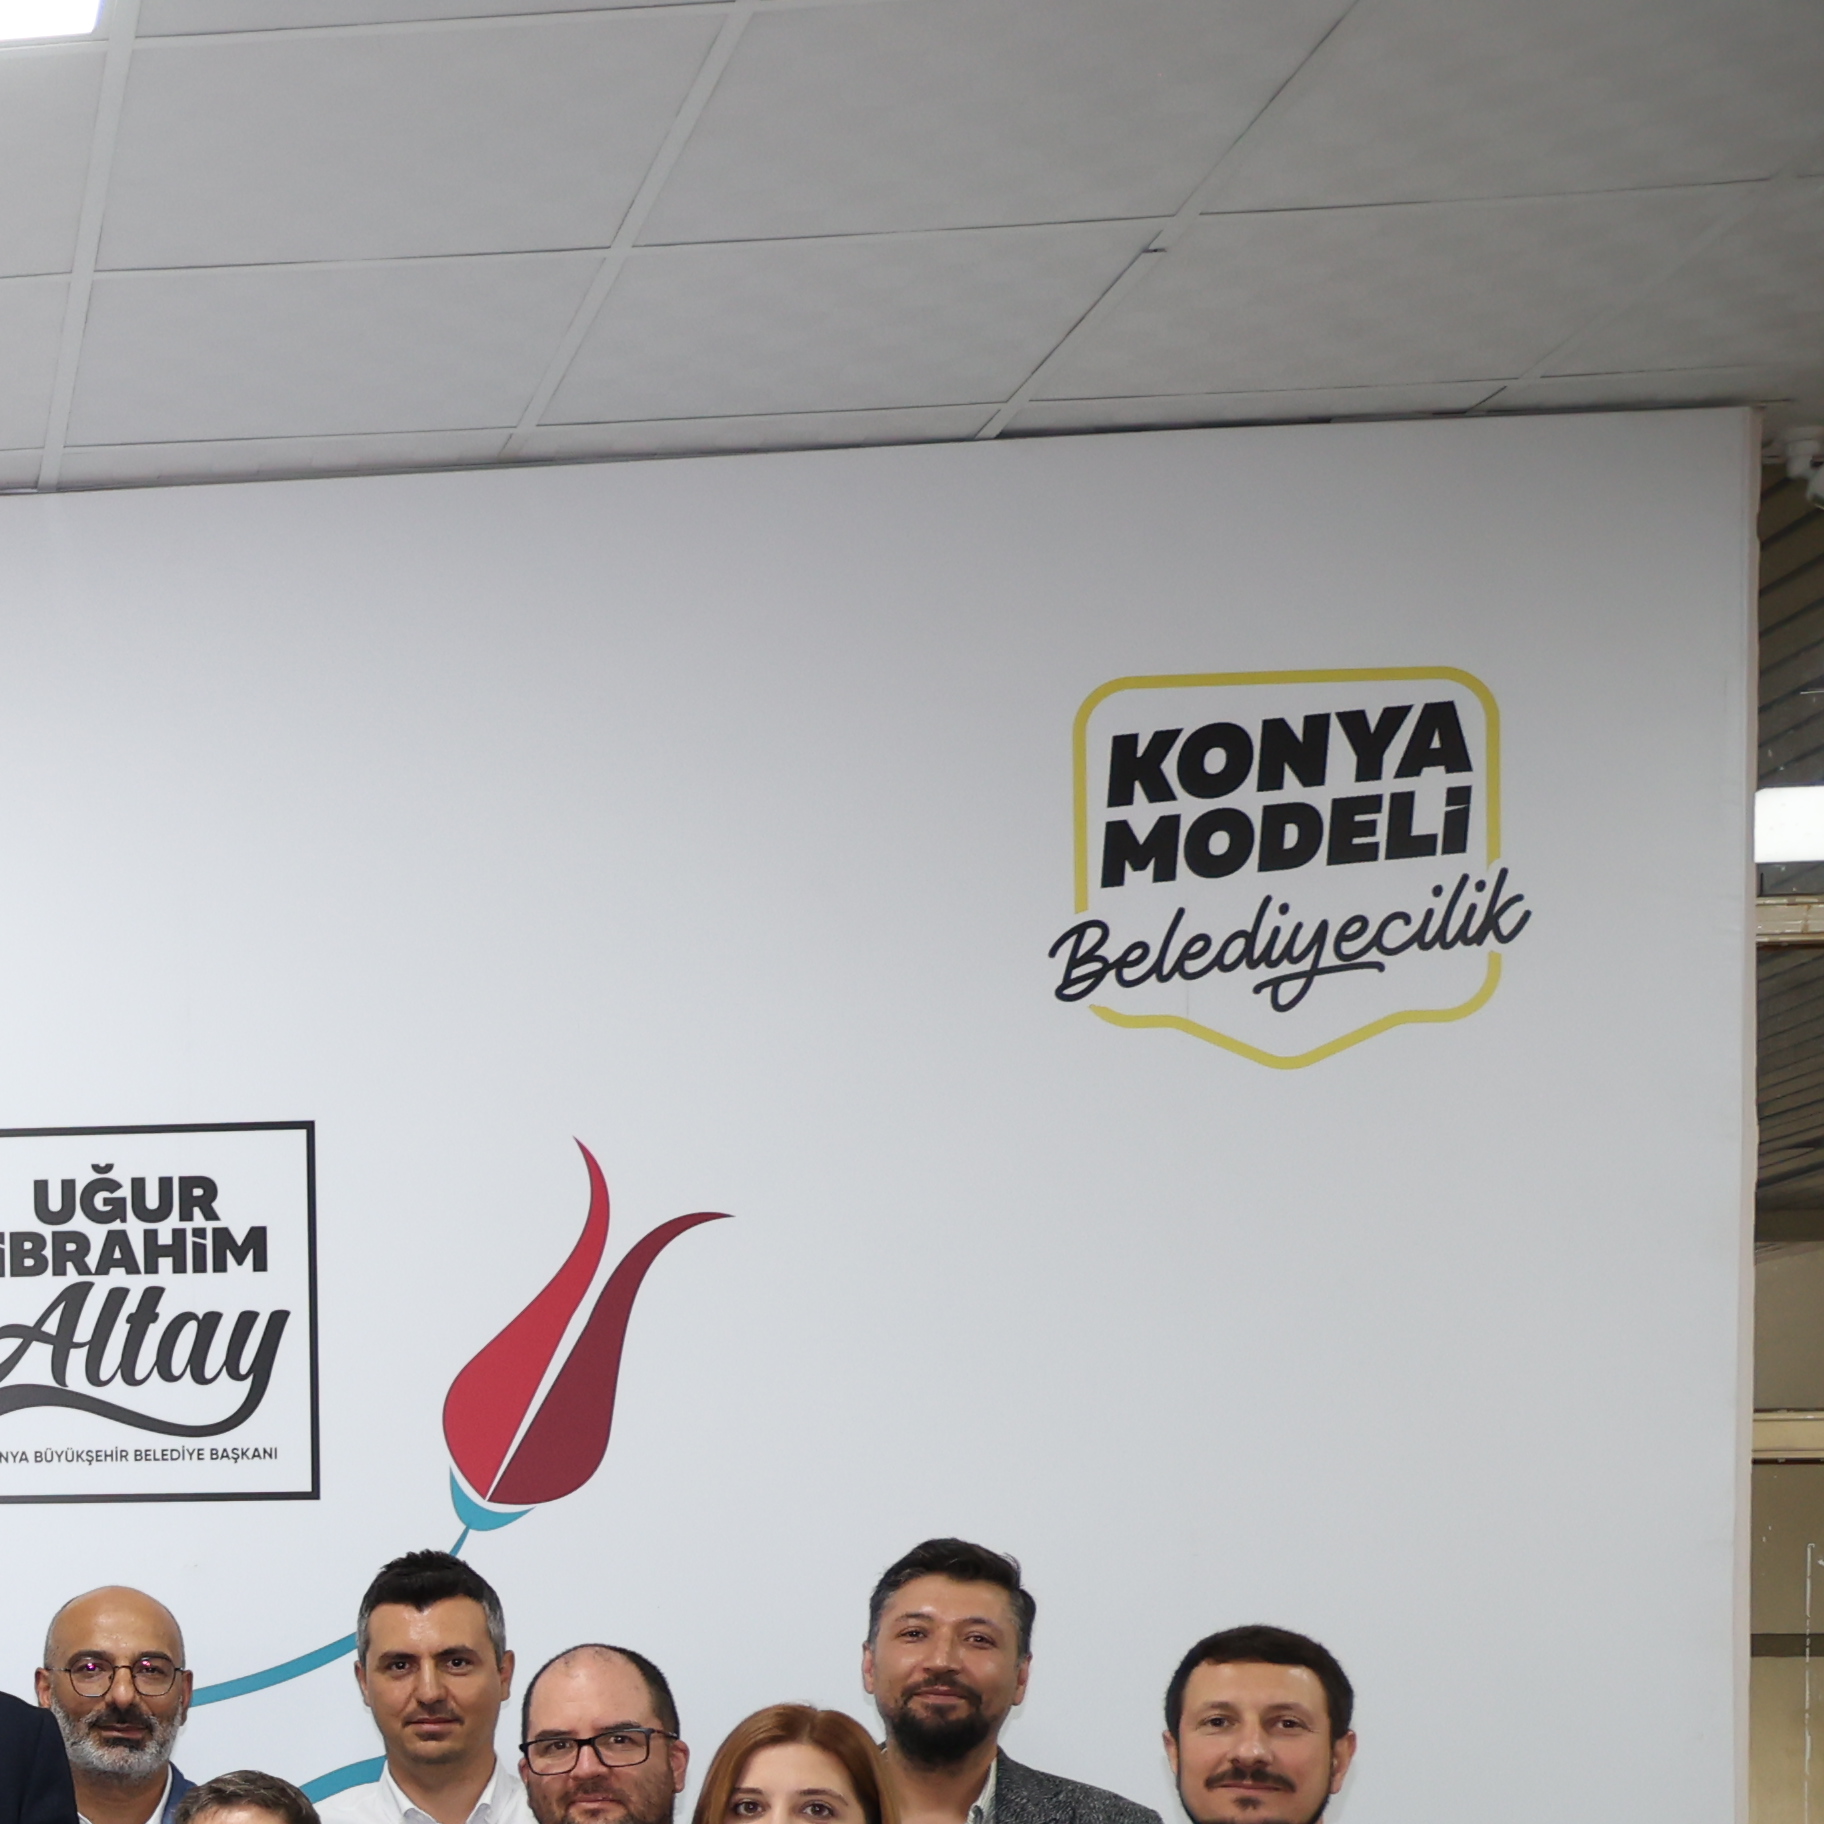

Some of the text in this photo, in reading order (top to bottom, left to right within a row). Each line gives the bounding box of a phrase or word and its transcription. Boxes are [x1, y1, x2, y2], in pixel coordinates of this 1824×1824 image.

[1106, 700, 1473, 808] KONYA
[1100, 785, 1473, 888] MODELİ
[1048, 867, 1532, 1013] Belediyecilik
[33, 1163, 221, 1225] UĞUR
[34, 1446, 129, 1465] BÜYÜKŞEHİR
[133, 1445, 205, 1462] BELEDİYE
[209, 1447, 278, 1464] BAŞKANI
